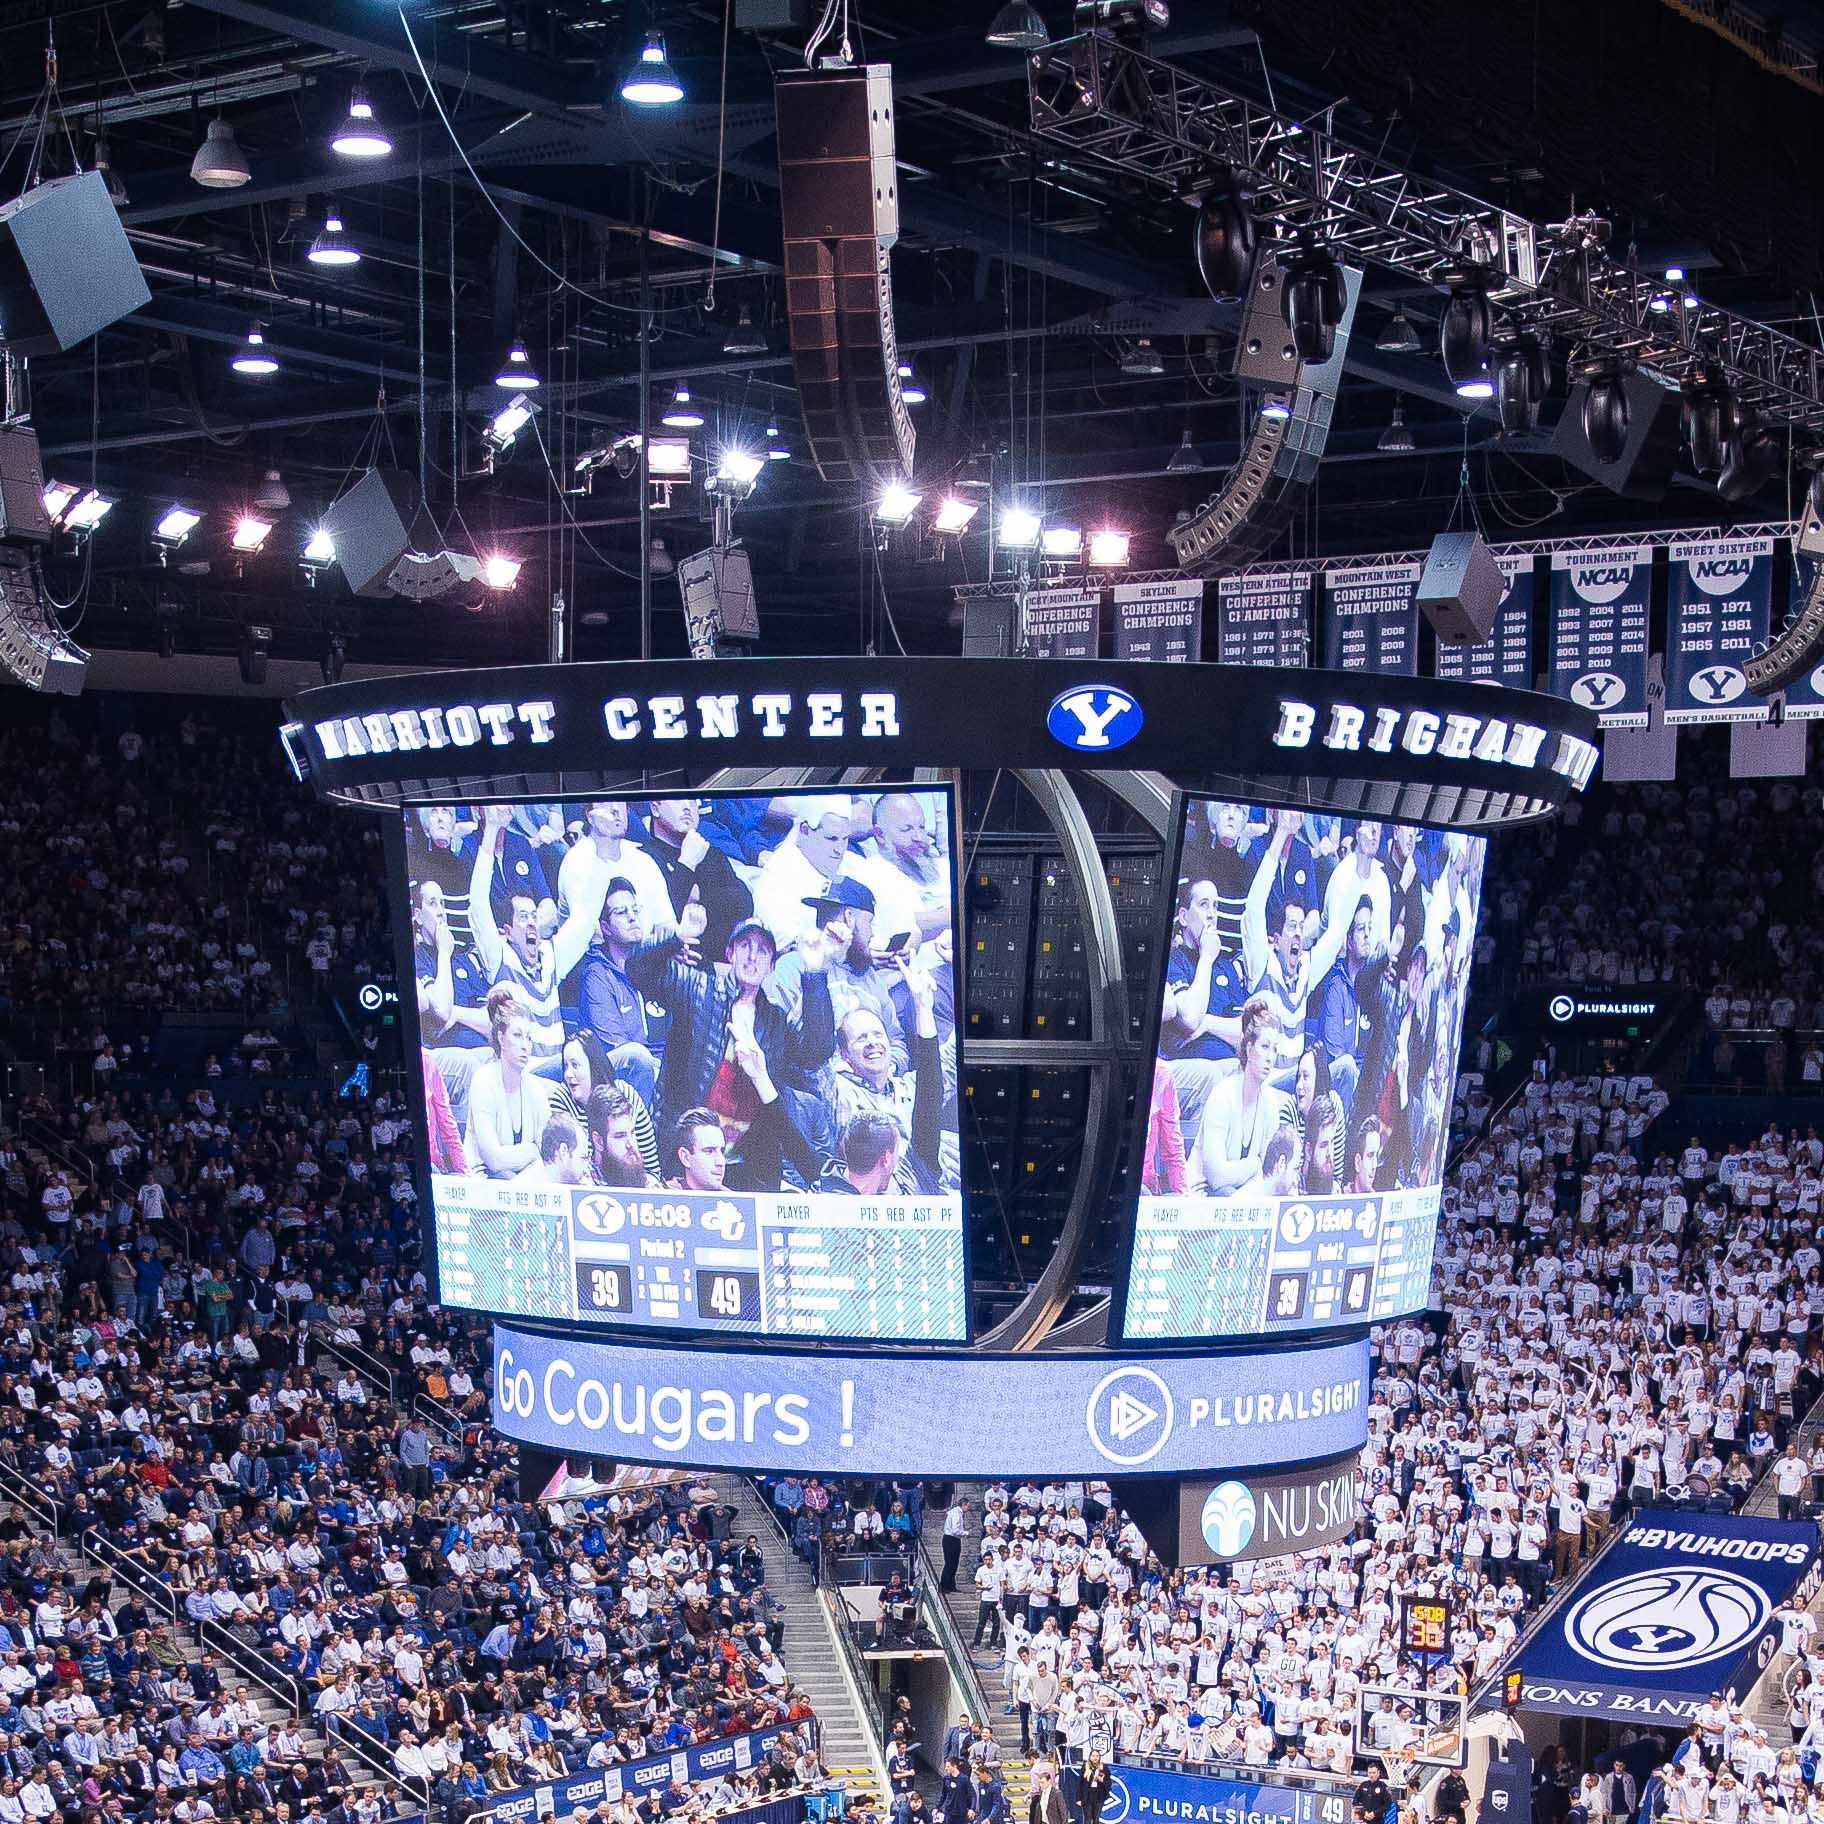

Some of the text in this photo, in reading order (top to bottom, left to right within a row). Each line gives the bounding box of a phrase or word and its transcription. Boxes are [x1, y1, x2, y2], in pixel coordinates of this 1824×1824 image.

[1675, 541, 1768, 557] SWEET SIXTEEN
[1565, 551, 1639, 566] TOURNAMENT
[1334, 569, 1413, 584] MOUNTAIN WEST
[1576, 567, 1632, 587] NCAA
[1696, 558, 1753, 579] NCAA
[1140, 586, 1177, 598] SKYLINE
[1265, 577, 1310, 590] ATHLTIC
[1333, 584, 1413, 602] CONFERENCE
[1028, 607, 1093, 623] ONFERENCE
[1121, 600, 1196, 617] CONFERENCE
[1336, 599, 1409, 616] CHAMPIONS
[1621, 604, 1644, 614] 2011
[1681, 601, 1752, 615] 1951 1971
[1123, 613, 1193, 629] CHAMPIONS
[1680, 620, 1752, 633] 1957 1981
[1720, 638, 1752, 650] 2011
[1380, 655, 1402, 665] 2011
[603, 693, 901, 741] CENTER
[1666, 711, 1768, 723] MEN'S BASKETBALL
[1786, 709, 1823, 719] MEN'S
[1272, 700, 1548, 769] BRIGHAM
[1577, 1003, 1656, 1014] PLURALSIGHT
[626, 1202, 693, 1229] 15:08
[776, 1205, 811, 1220] PLAYER
[859, 1207, 879, 1222] PTS
[912, 1208, 932, 1223] AST
[940, 1209, 953, 1223] PF
[590, 1269, 620, 1308] 39
[710, 1276, 742, 1316] 49
[1276, 1278, 1300, 1316] 39
[497, 1347, 534, 1420] Go
[543, 1358, 811, 1453] Cougars
[1189, 1380, 1362, 1428] PLURALSIGHT
[1263, 1472, 1355, 1543] NU SKIN
[1624, 1527, 1809, 1565] #BYUHOOPS
[1607, 1694, 1713, 1721] BANK
[1321, 1796, 1345, 1824] 49
